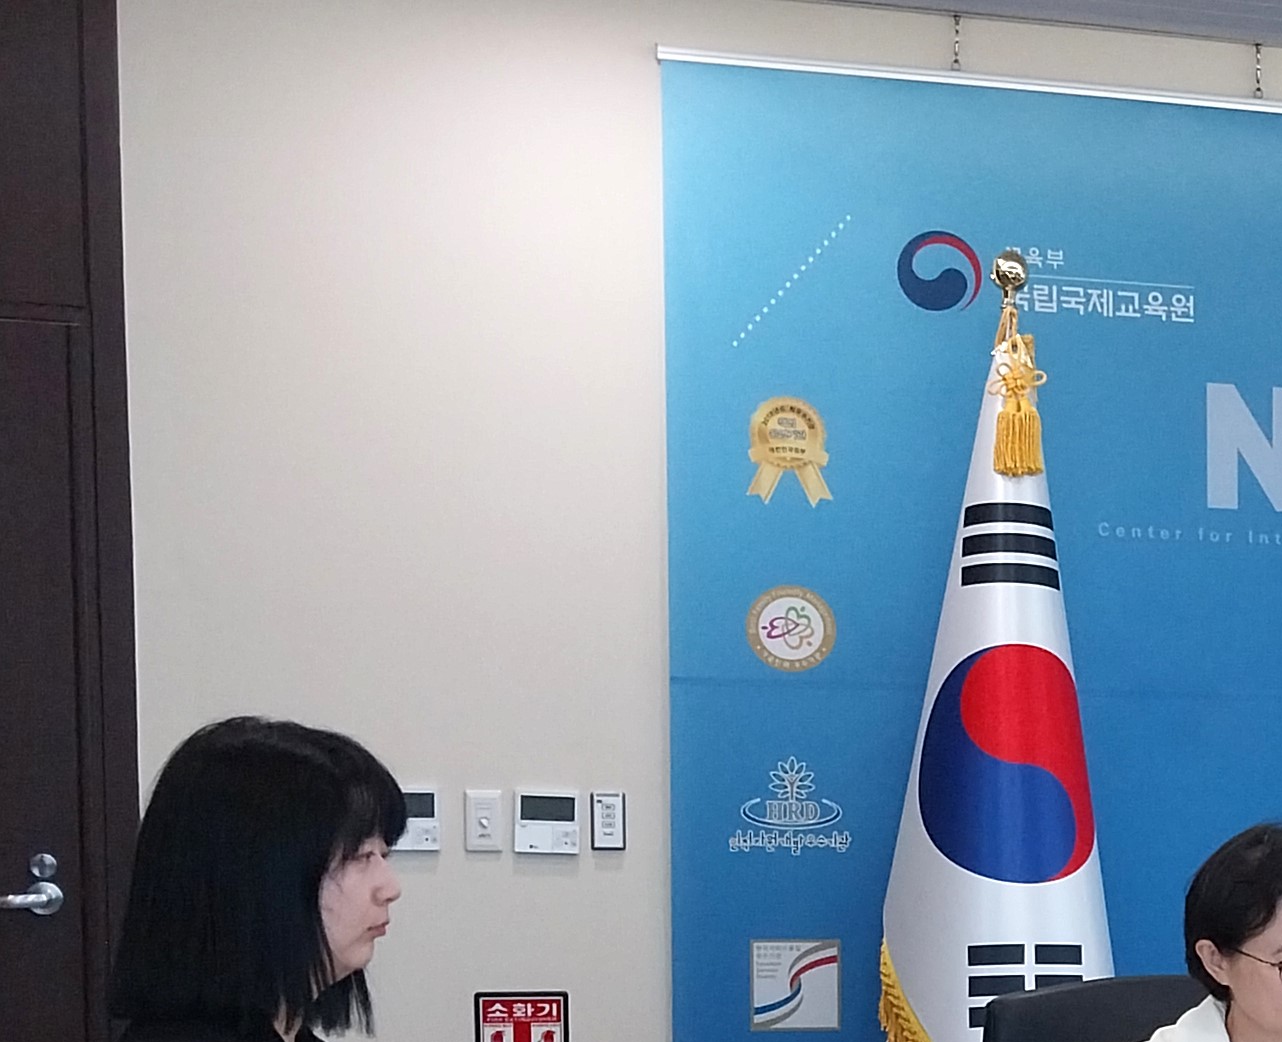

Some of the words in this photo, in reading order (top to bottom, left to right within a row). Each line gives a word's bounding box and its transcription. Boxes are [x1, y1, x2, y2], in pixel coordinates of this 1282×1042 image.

[1006, 247, 1064, 270] 육부
[1098, 521, 1183, 540] Center
[1197, 526, 1233, 543] for
[766, 800, 820, 822] HRD
[486, 1002, 557, 1018] 소화기
